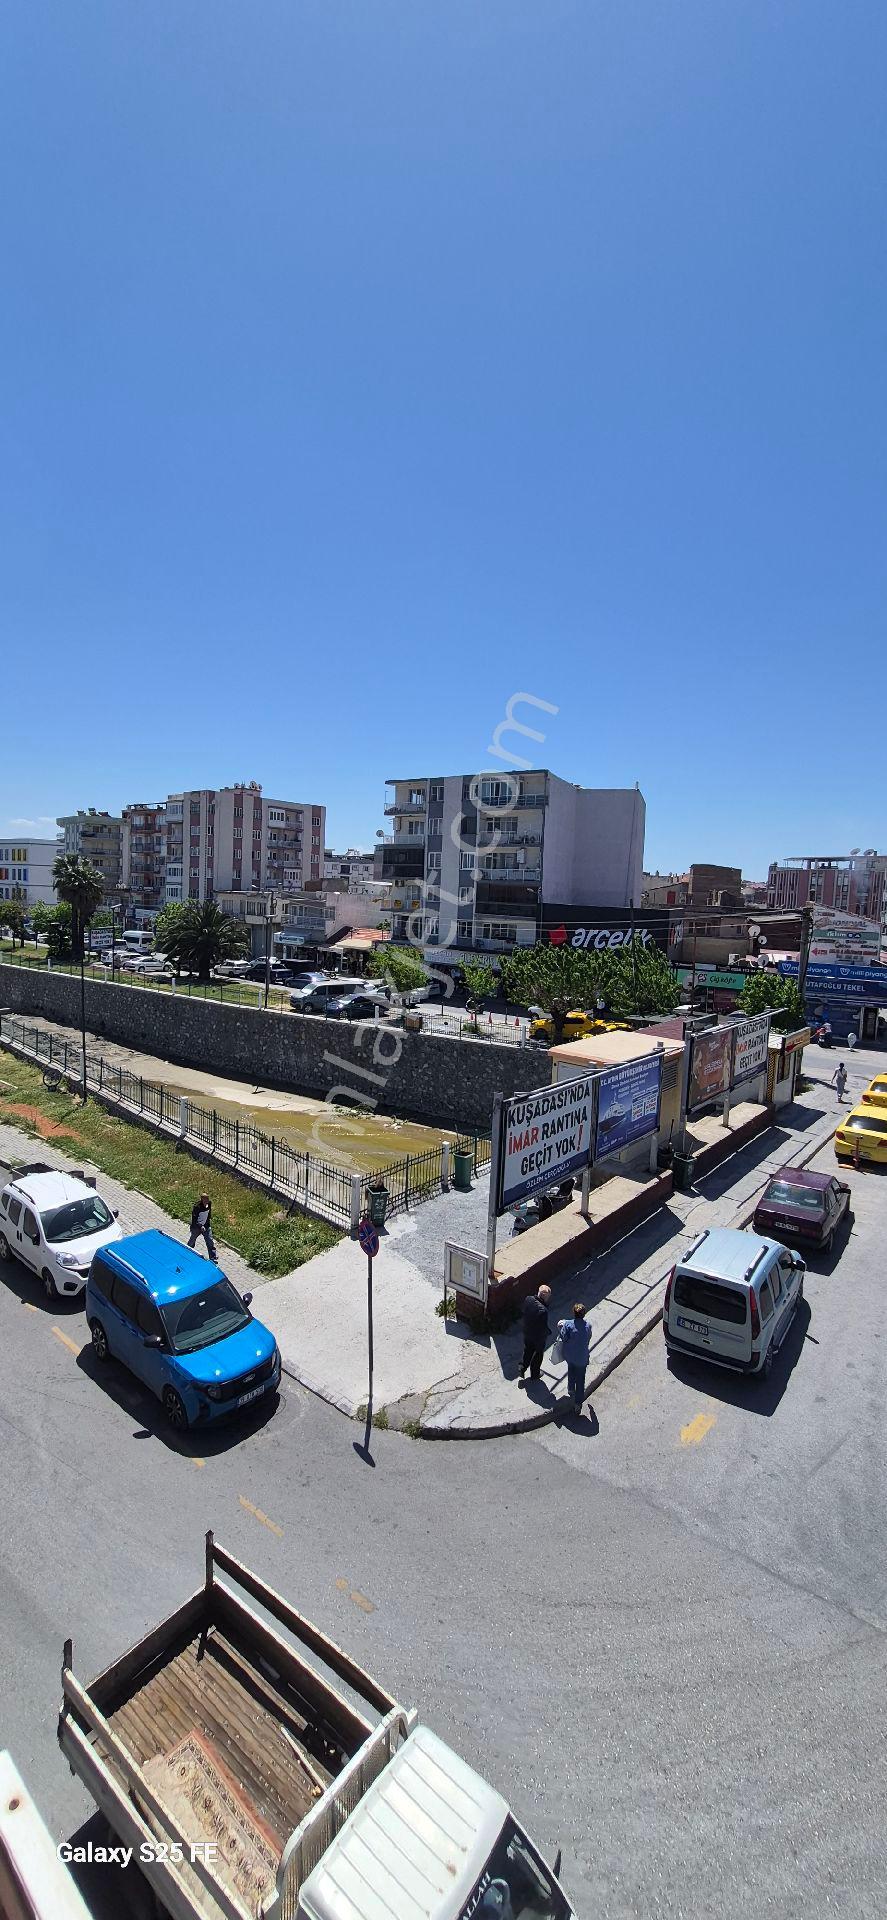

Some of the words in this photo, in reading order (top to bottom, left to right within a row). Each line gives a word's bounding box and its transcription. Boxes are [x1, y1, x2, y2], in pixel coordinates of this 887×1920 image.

[805, 981, 841, 990] UTAFOĞLU
[842, 983, 866, 992] TEKEL
[508, 1081, 590, 1128] KUŞADASI'NDA
[508, 1127, 539, 1155] İMAR
[541, 1106, 588, 1140] RANTINA
[520, 1143, 553, 1175] GEÇİT
